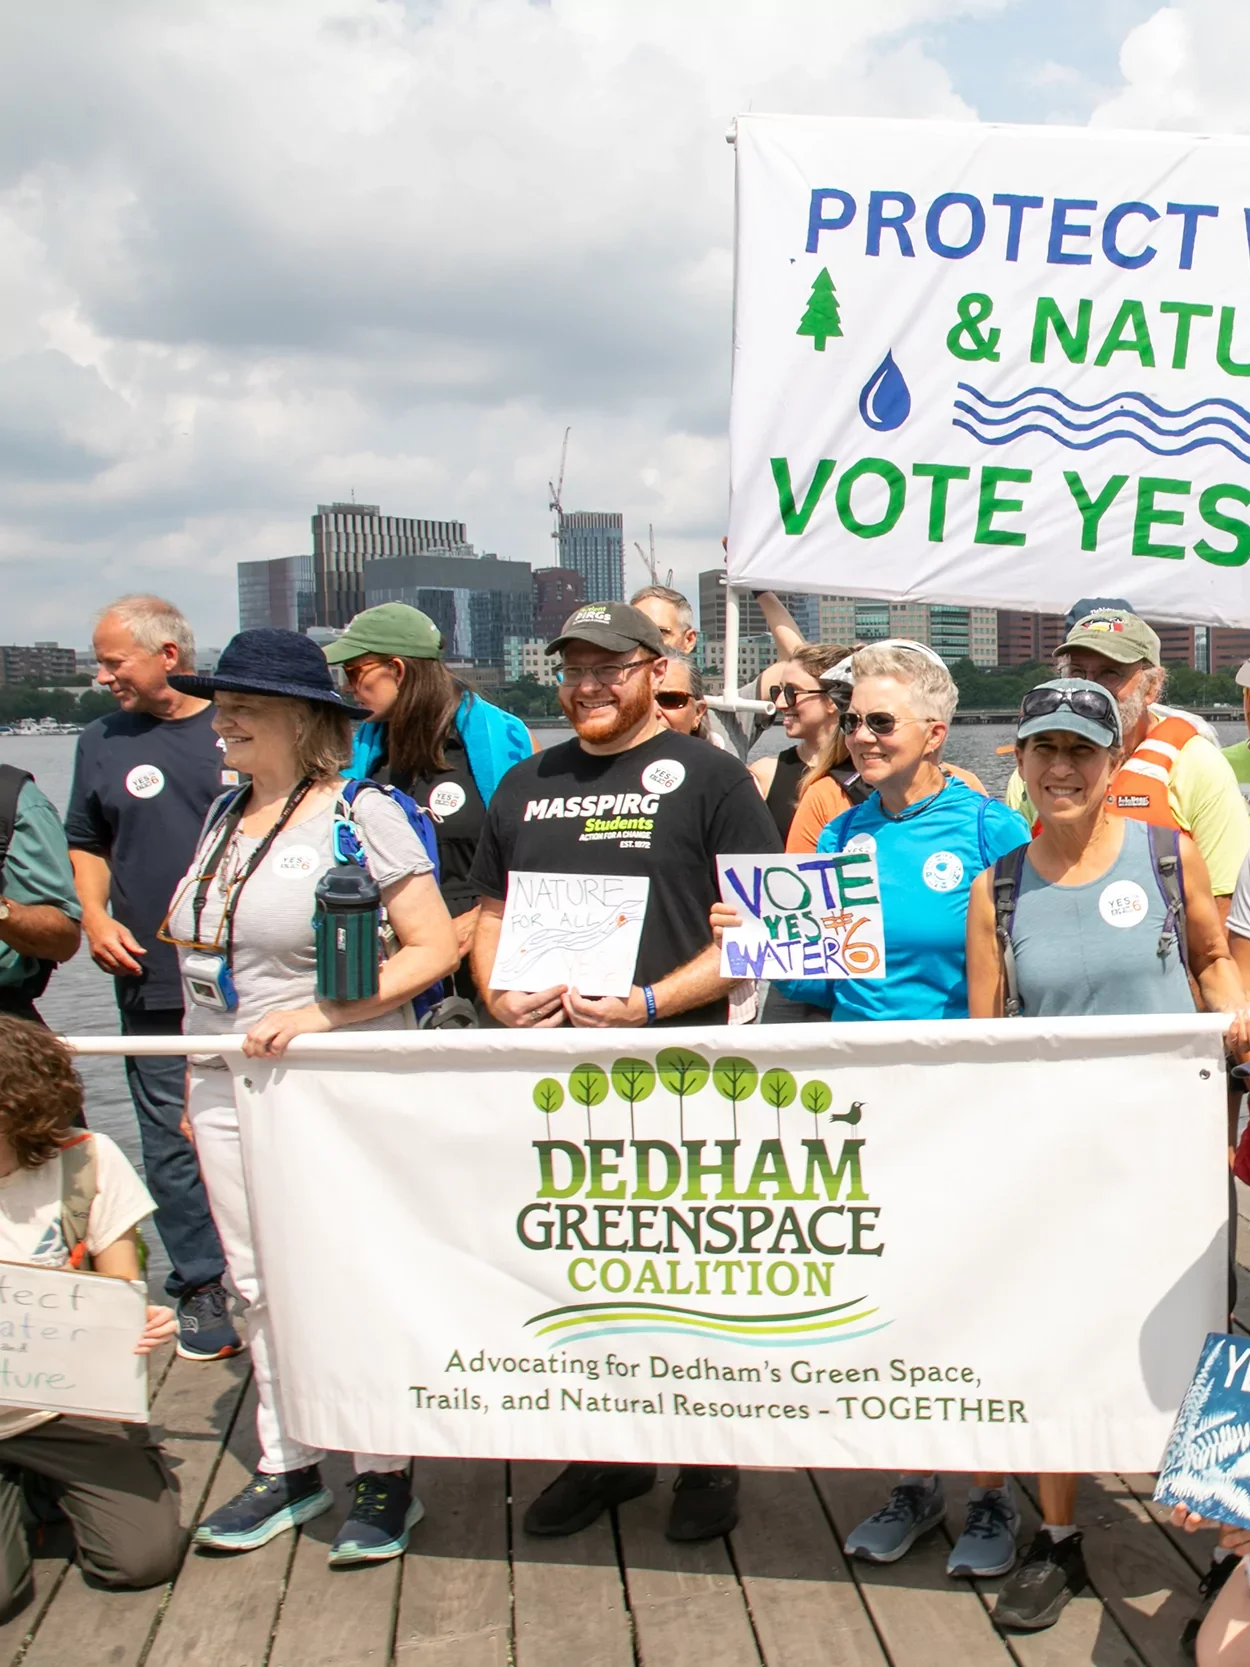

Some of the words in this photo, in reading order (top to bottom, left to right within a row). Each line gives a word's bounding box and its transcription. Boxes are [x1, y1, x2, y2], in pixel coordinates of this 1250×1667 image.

[806, 187, 1219, 270] PROTECT
[946, 291, 1000, 362] &
[770, 457, 1032, 547] VOTE
[654, 768, 672, 780] YES
[664, 779, 675, 788] 6
[436, 793, 452, 801] YES
[449, 799, 458, 808] 6
[523, 793, 660, 821] MASSPIRG
[584, 816, 654, 833] Students
[283, 856, 302, 864] YES
[301, 862, 311, 871] 6
[513, 876, 624, 911] NATURE
[724, 853, 880, 920] VOTE
[1108, 896, 1132, 909] YES
[1132, 899, 1142, 911] 6
[511, 912, 544, 932] FOR
[560, 911, 601, 928] ALL
[763, 911, 822, 943] YES
[726, 937, 850, 979] WATER
[532, 1138, 870, 1202] DEDHAM
[515, 1202, 885, 1257] GREENSPACE
[567, 1257, 835, 1297] COALITION
[444, 1349, 600, 1380] Advocating
[605, 1353, 640, 1377] for
[650, 1355, 782, 1384] Dedham's
[790, 1359, 880, 1384] Green
[889, 1358, 982, 1388] Space,
[408, 1385, 490, 1414] Trails,
[501, 1388, 551, 1411] and
[560, 1387, 665, 1416] Natural
[673, 1392, 811, 1419] Resources
[836, 1395, 1029, 1423] TOGETHER
